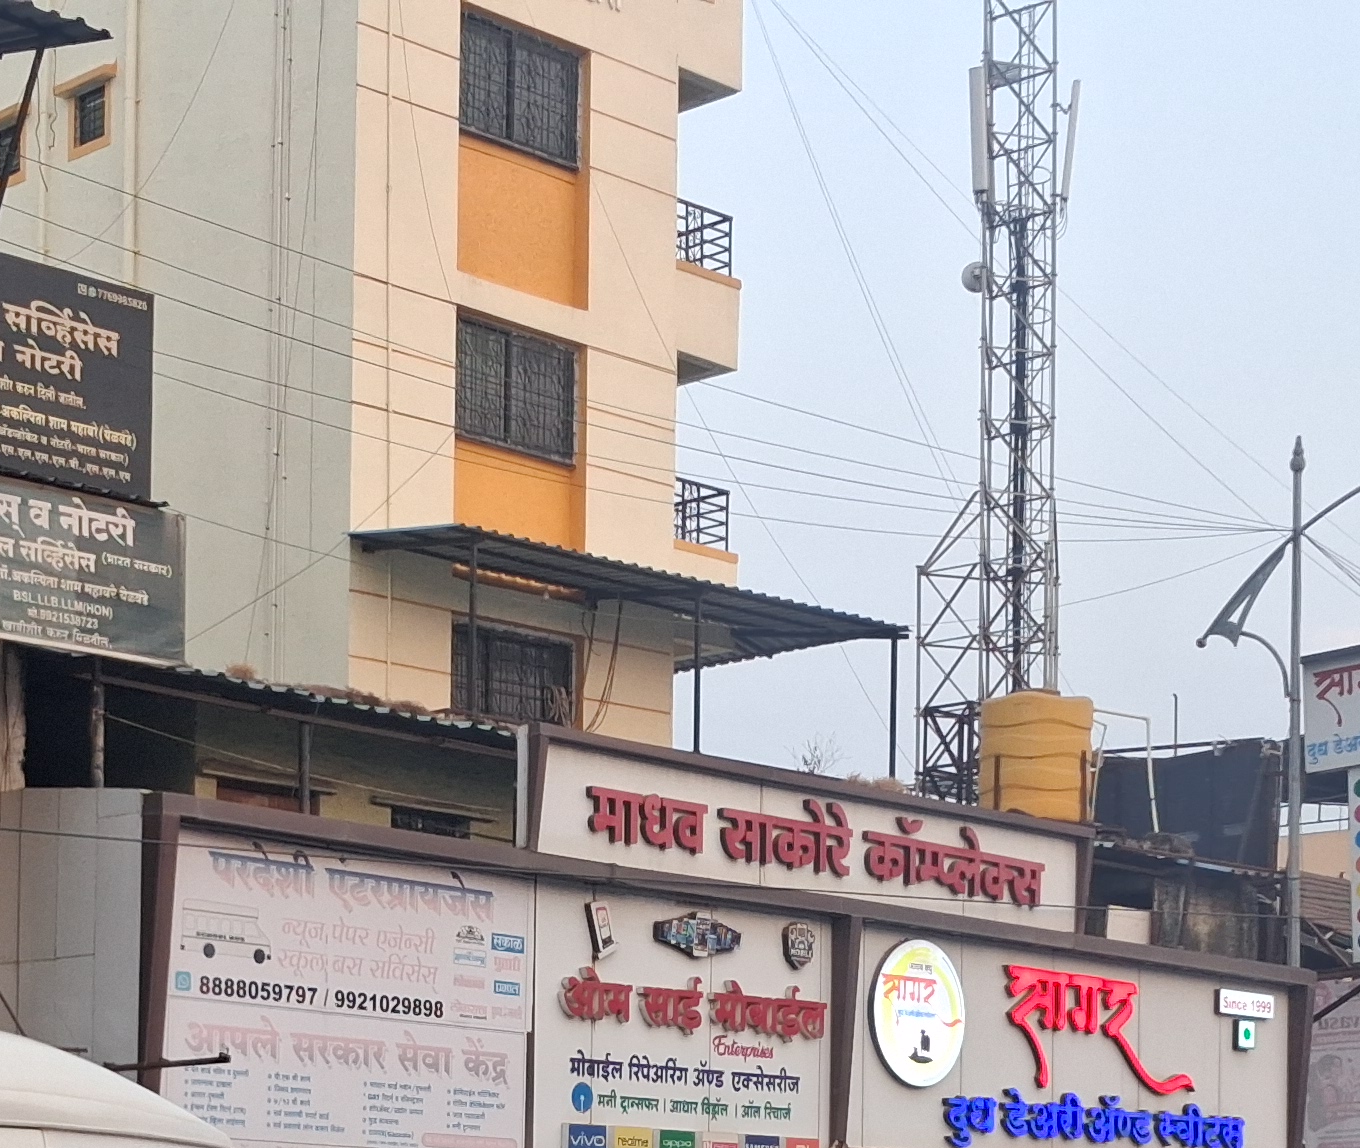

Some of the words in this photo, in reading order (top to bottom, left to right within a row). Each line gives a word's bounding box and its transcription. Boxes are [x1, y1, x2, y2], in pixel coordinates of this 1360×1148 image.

[13, 337, 83, 383] नोटरी
[27, 498, 52, 531] व
[58, 498, 136, 547] नोटरी
[585, 783, 708, 855] माधव
[716, 798, 853, 878] साकोरे
[862, 815, 1046, 909] कॉम्प्लेक्स
[199, 974, 319, 1008] 8888059797
[334, 988, 445, 1020] 9921029898
[557, 965, 634, 1024] ओम
[636, 975, 704, 1037] साई
[707, 979, 828, 1044] मोबाईल
[1222, 994, 1248, 1012] Since
[1250, 999, 1272, 1015] 1999
[183, 1014, 282, 1062] आपले
[289, 1030, 388, 1072] सरकार
[395, 1030, 452, 1078] सेवा
[461, 1035, 511, 1086] केंद्र
[1002, 963, 1195, 1095] सागर
[569, 1048, 624, 1083] मोबाईल
[628, 1053, 688, 1087] रिपेअरिंग
[731, 1064, 801, 1095] एक्सेसरीज
[597, 1088, 617, 1109] मनी
[619, 1094, 660, 1115] ट्रान्सफर
[669, 1097, 698, 1116] आधार
[740, 1099, 761, 1118] ऑल
[942, 1094, 998, 1148] दुध
[1000, 1087, 1085, 1141] डेअरी
[570, 1131, 606, 1148] vivo
[617, 1135, 649, 1148] realme
[662, 1138, 692, 1148] oppo
